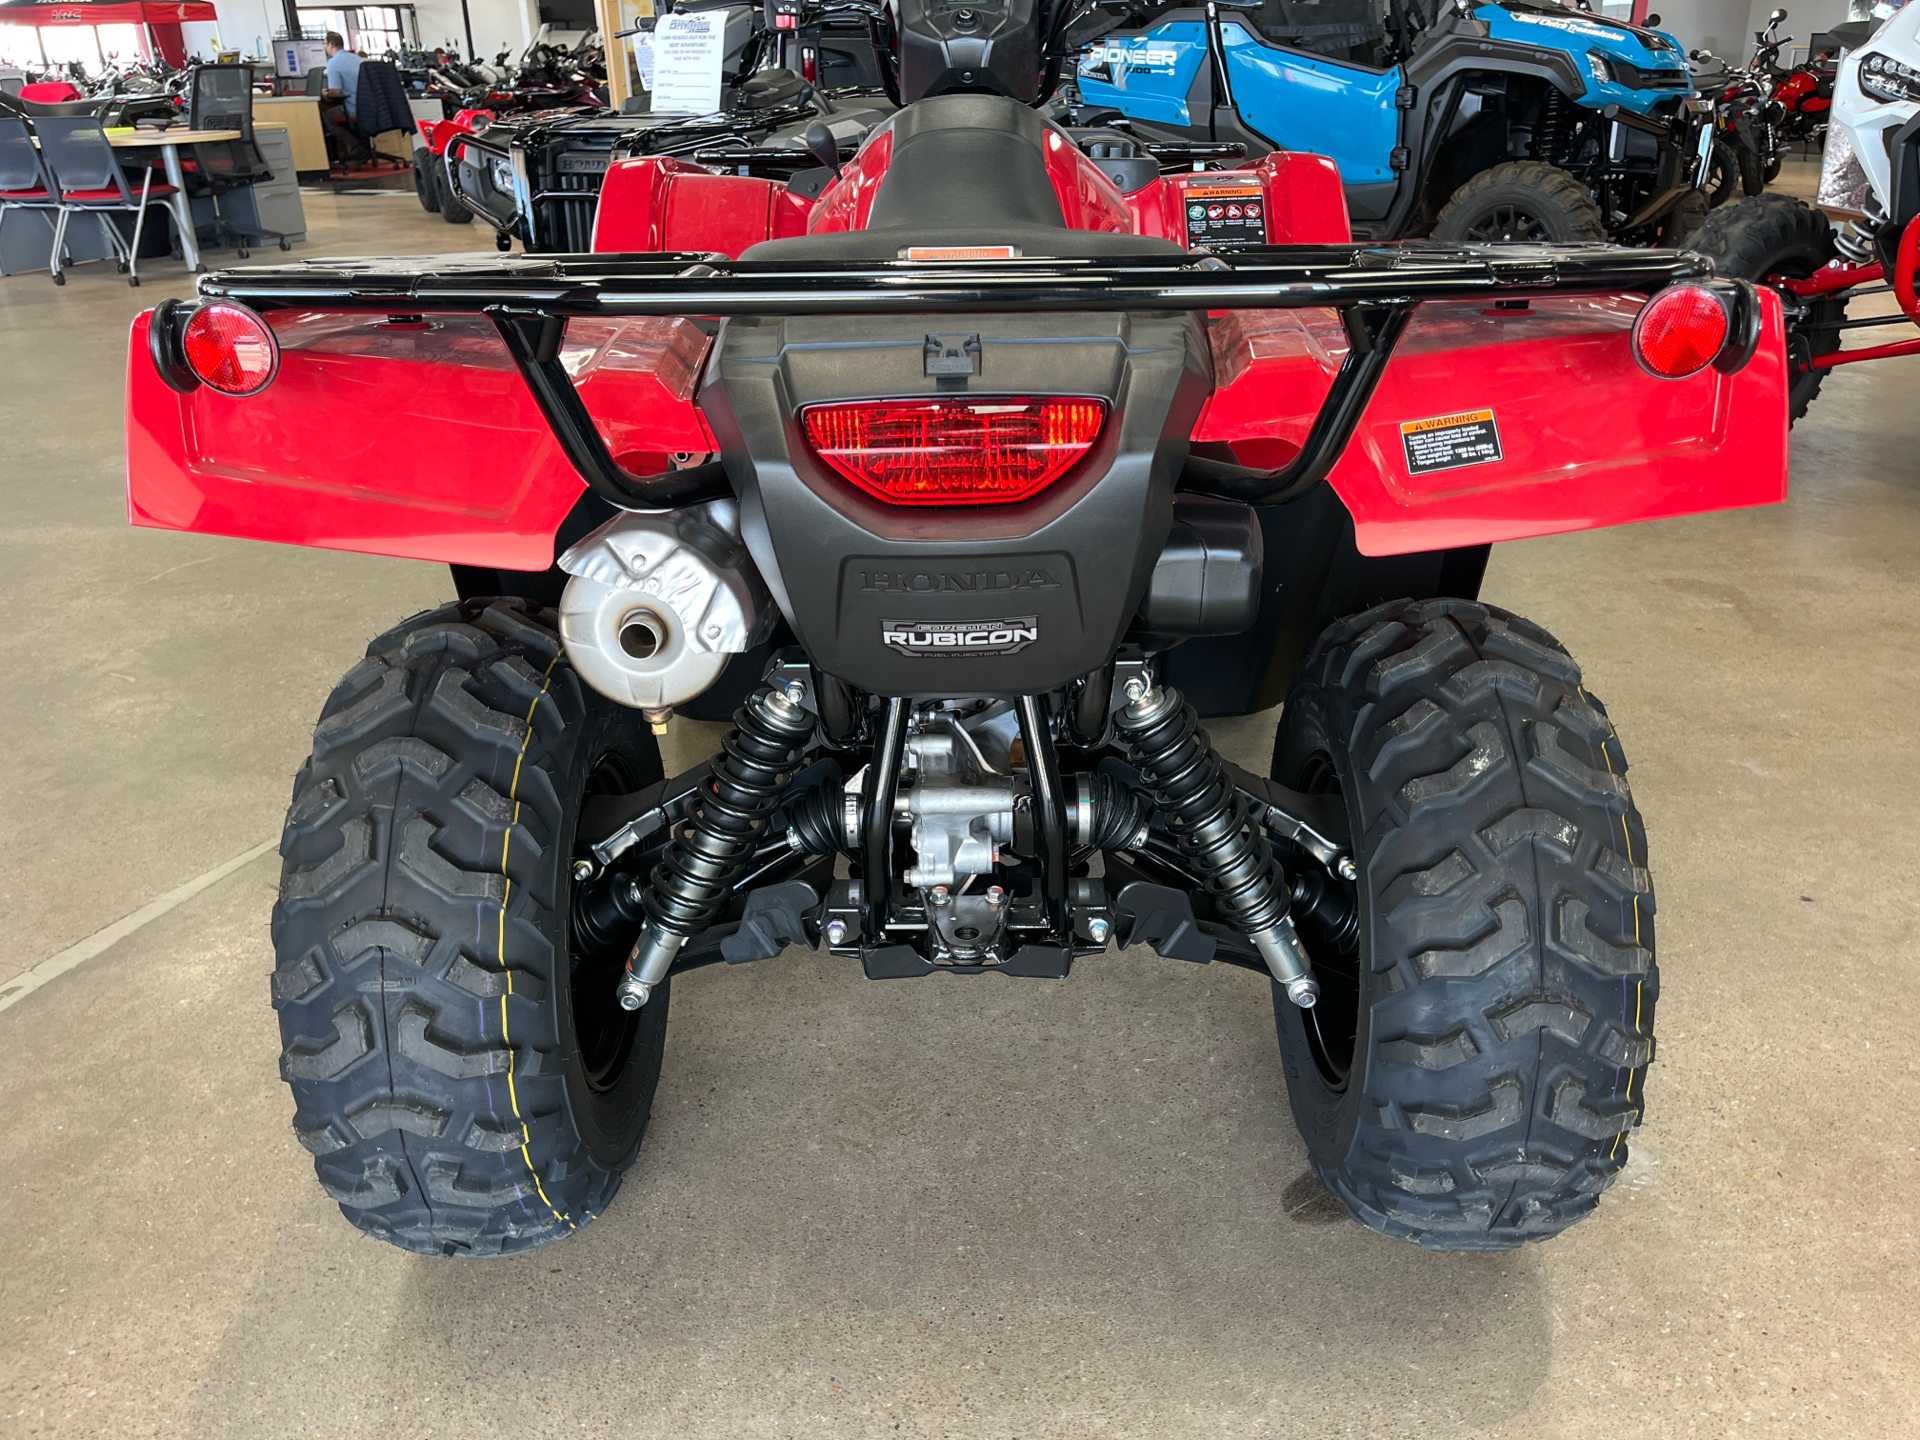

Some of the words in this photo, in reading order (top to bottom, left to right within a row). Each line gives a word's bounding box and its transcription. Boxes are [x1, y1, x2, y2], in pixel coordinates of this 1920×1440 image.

[52, 9, 82, 22] HRC
[1518, 15, 1539, 24] Dual
[1539, 18, 1567, 30] Clutch
[1567, 23, 1626, 41] Transmission
[1090, 47, 1177, 66] PIONEER
[1079, 69, 1109, 80] HONDA
[562, 159, 607, 170] HOND
[943, 250, 990, 258] WARNING
[1426, 413, 1478, 428] WARNING
[859, 568, 1061, 593] HONDA
[917, 622, 1003, 632] FOREMAN
[883, 627, 1037, 646] RUBICON
